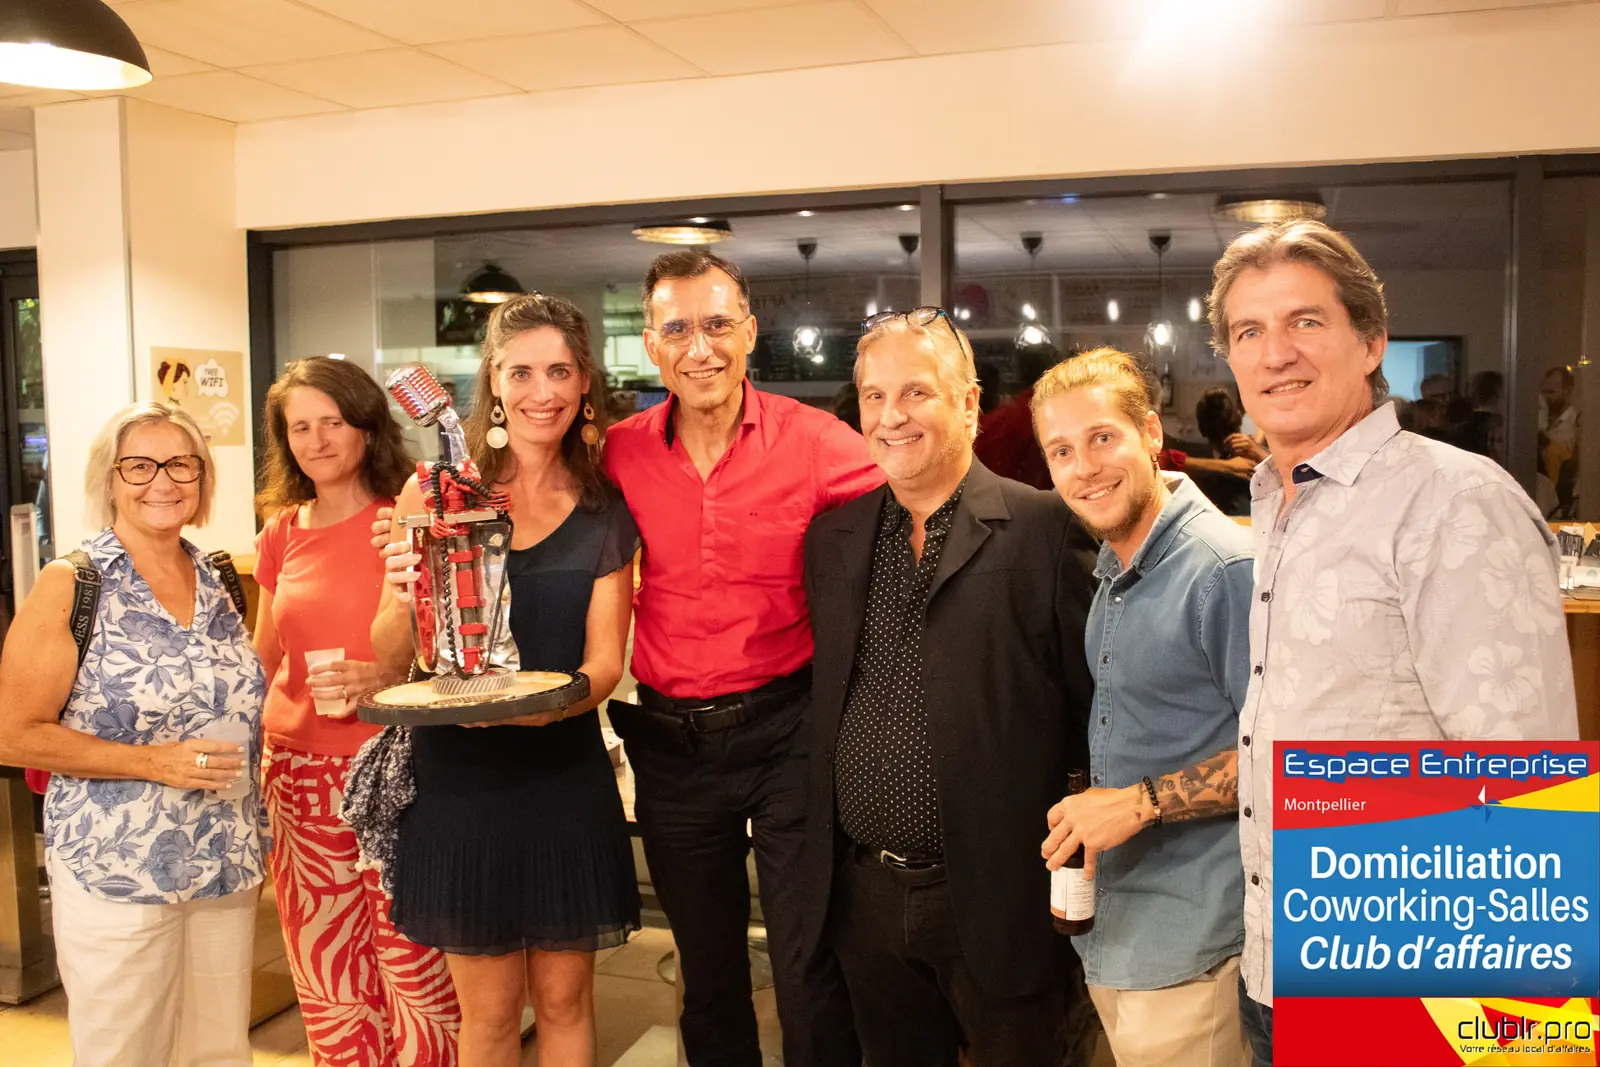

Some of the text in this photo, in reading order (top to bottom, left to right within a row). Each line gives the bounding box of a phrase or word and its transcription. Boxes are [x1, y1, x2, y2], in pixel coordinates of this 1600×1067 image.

[200, 377, 223, 387] WIFI
[81, 583, 95, 610] 1981
[74, 615, 90, 645] UESS
